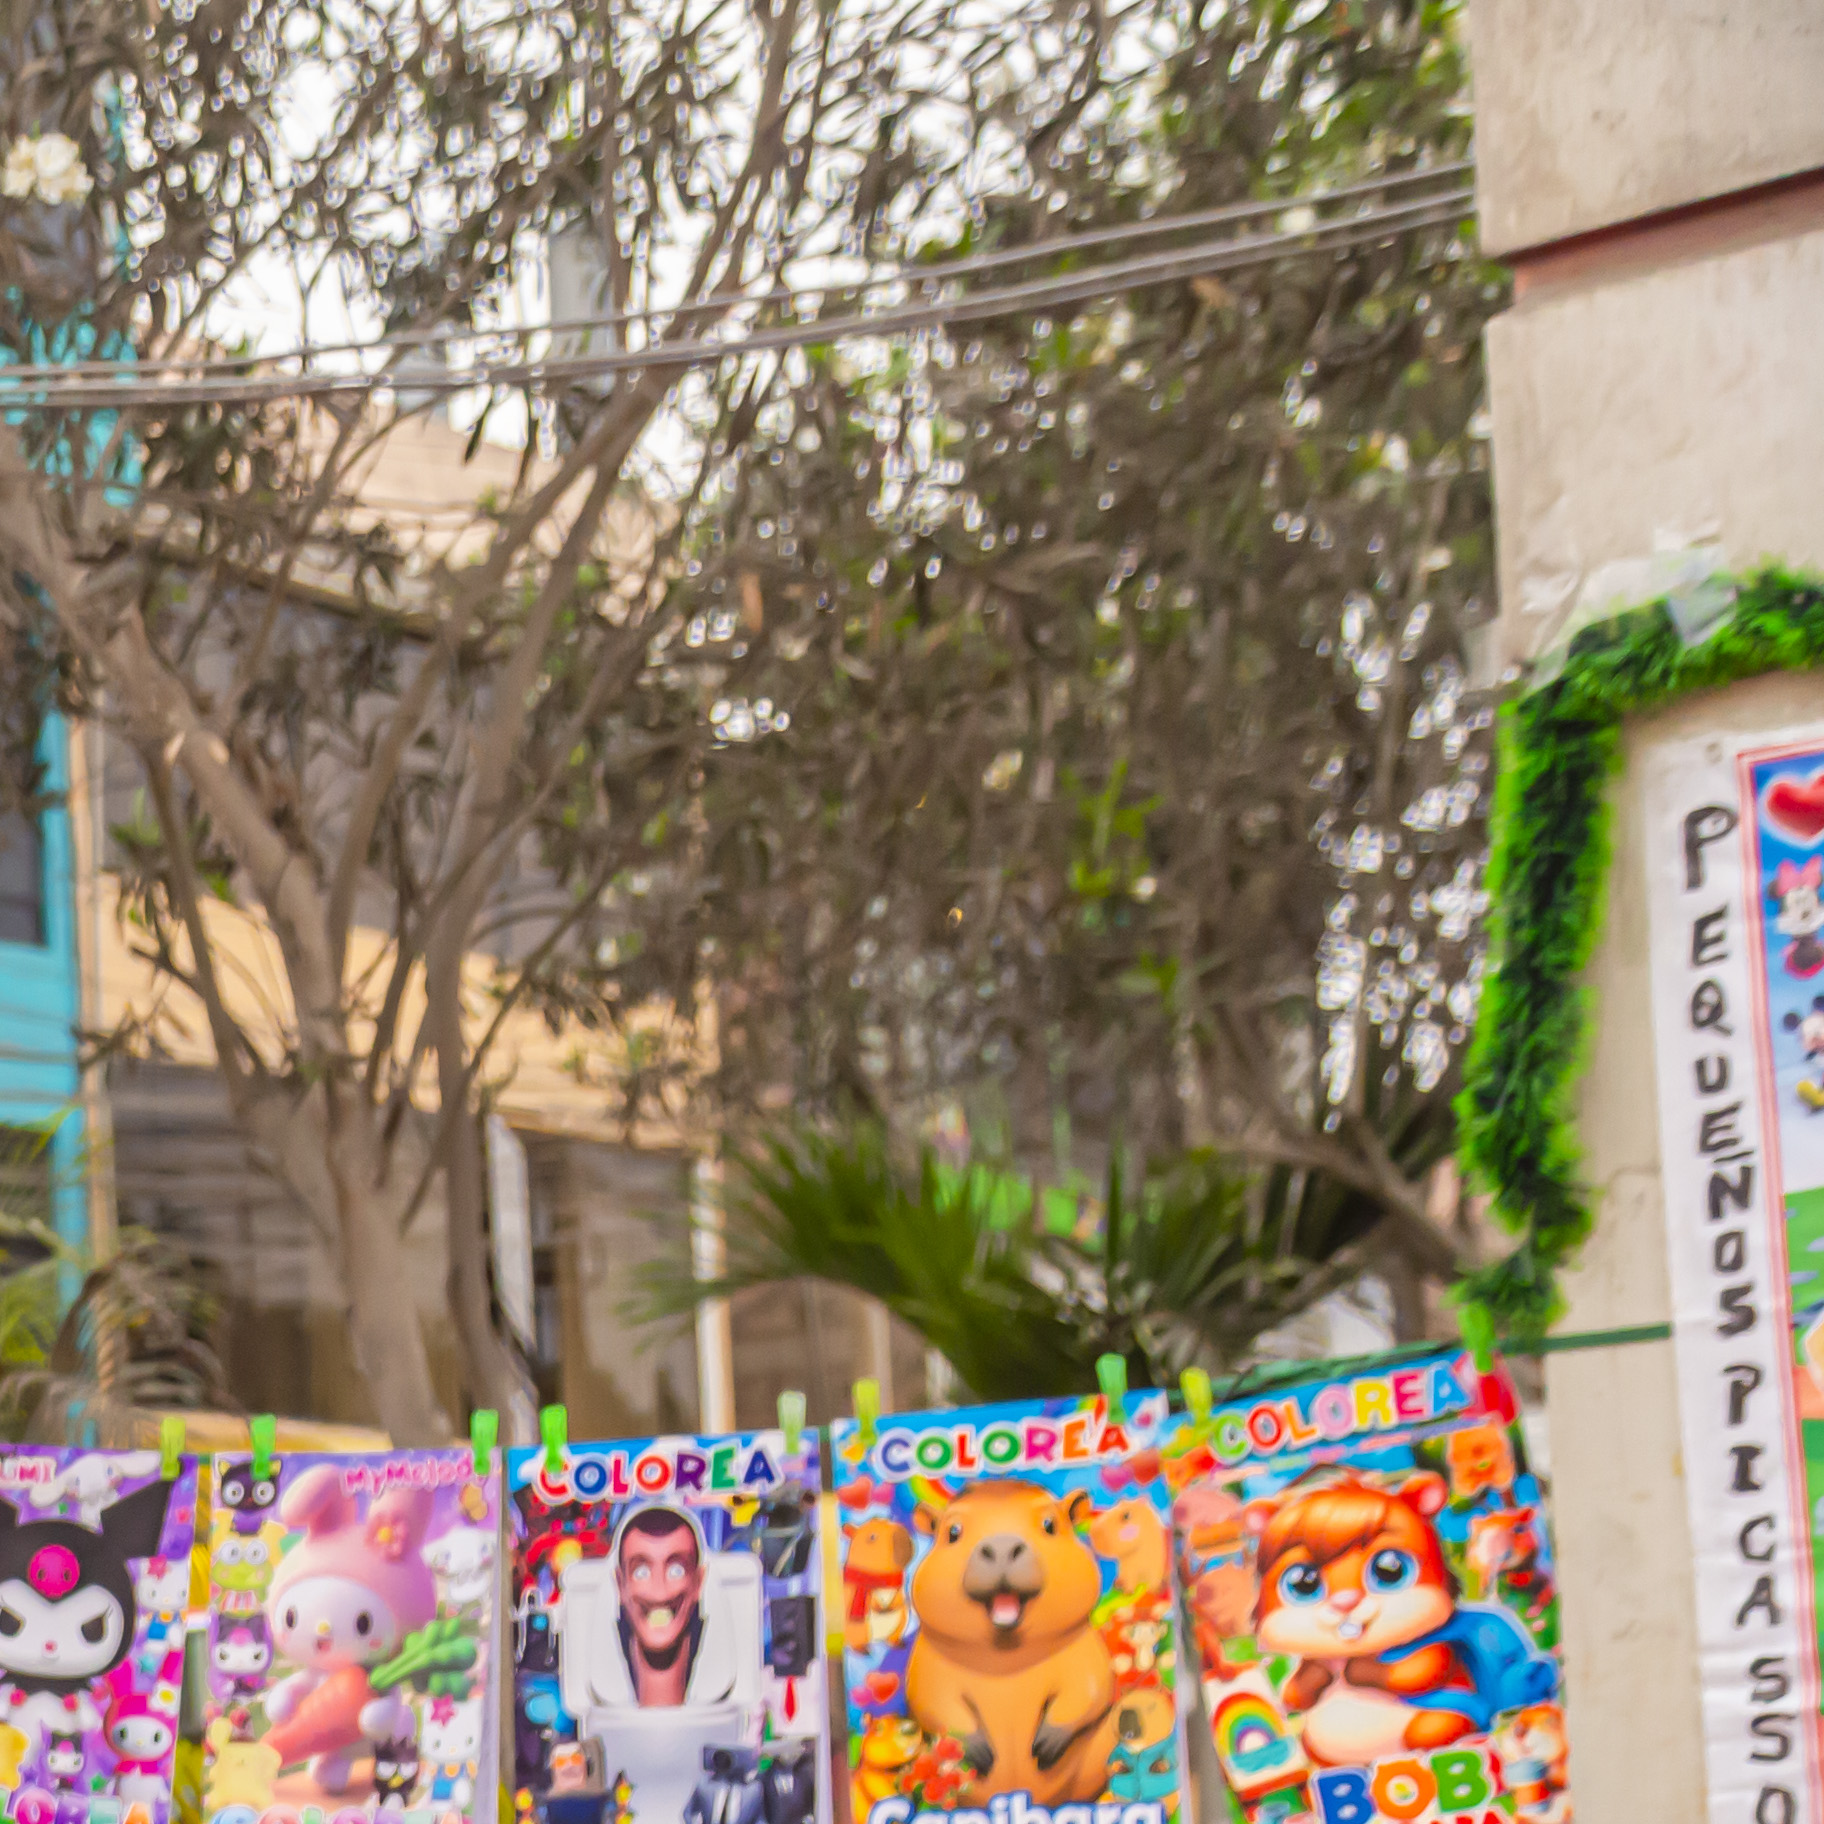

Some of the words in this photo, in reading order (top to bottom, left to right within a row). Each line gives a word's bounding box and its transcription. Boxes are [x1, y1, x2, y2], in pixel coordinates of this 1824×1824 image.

[1212, 1366, 1470, 1459] COLOREA
[539, 1446, 776, 1497] COLOREA
[881, 1419, 1129, 1473] COLOREA
